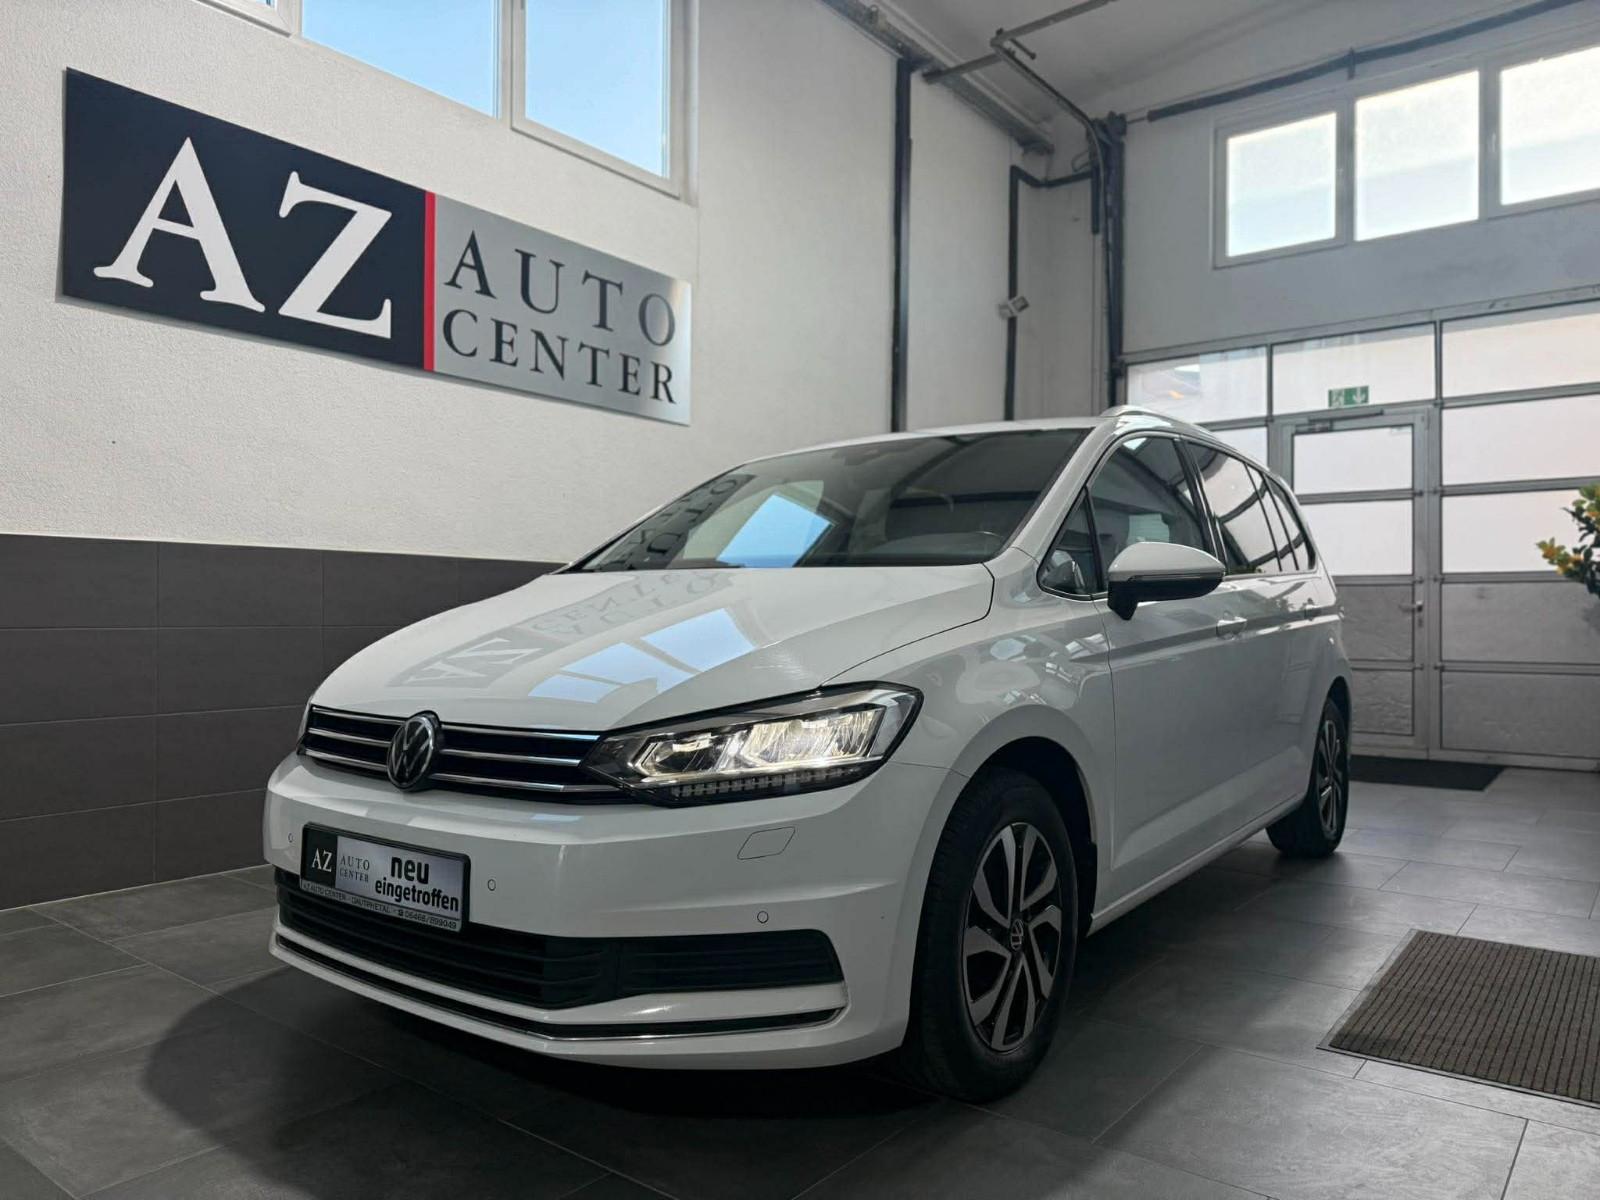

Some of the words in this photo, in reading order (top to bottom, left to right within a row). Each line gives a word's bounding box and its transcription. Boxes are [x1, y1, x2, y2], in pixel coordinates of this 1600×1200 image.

[94, 136, 393, 340] AZ
[444, 229, 677, 348] AUTO
[442, 308, 678, 406] CENTER
[311, 847, 333, 873] AZ
[340, 855, 370, 871] AUTO
[340, 868, 369, 883] CENTER
[390, 856, 430, 885] neu
[374, 876, 459, 912] eingetroffen
